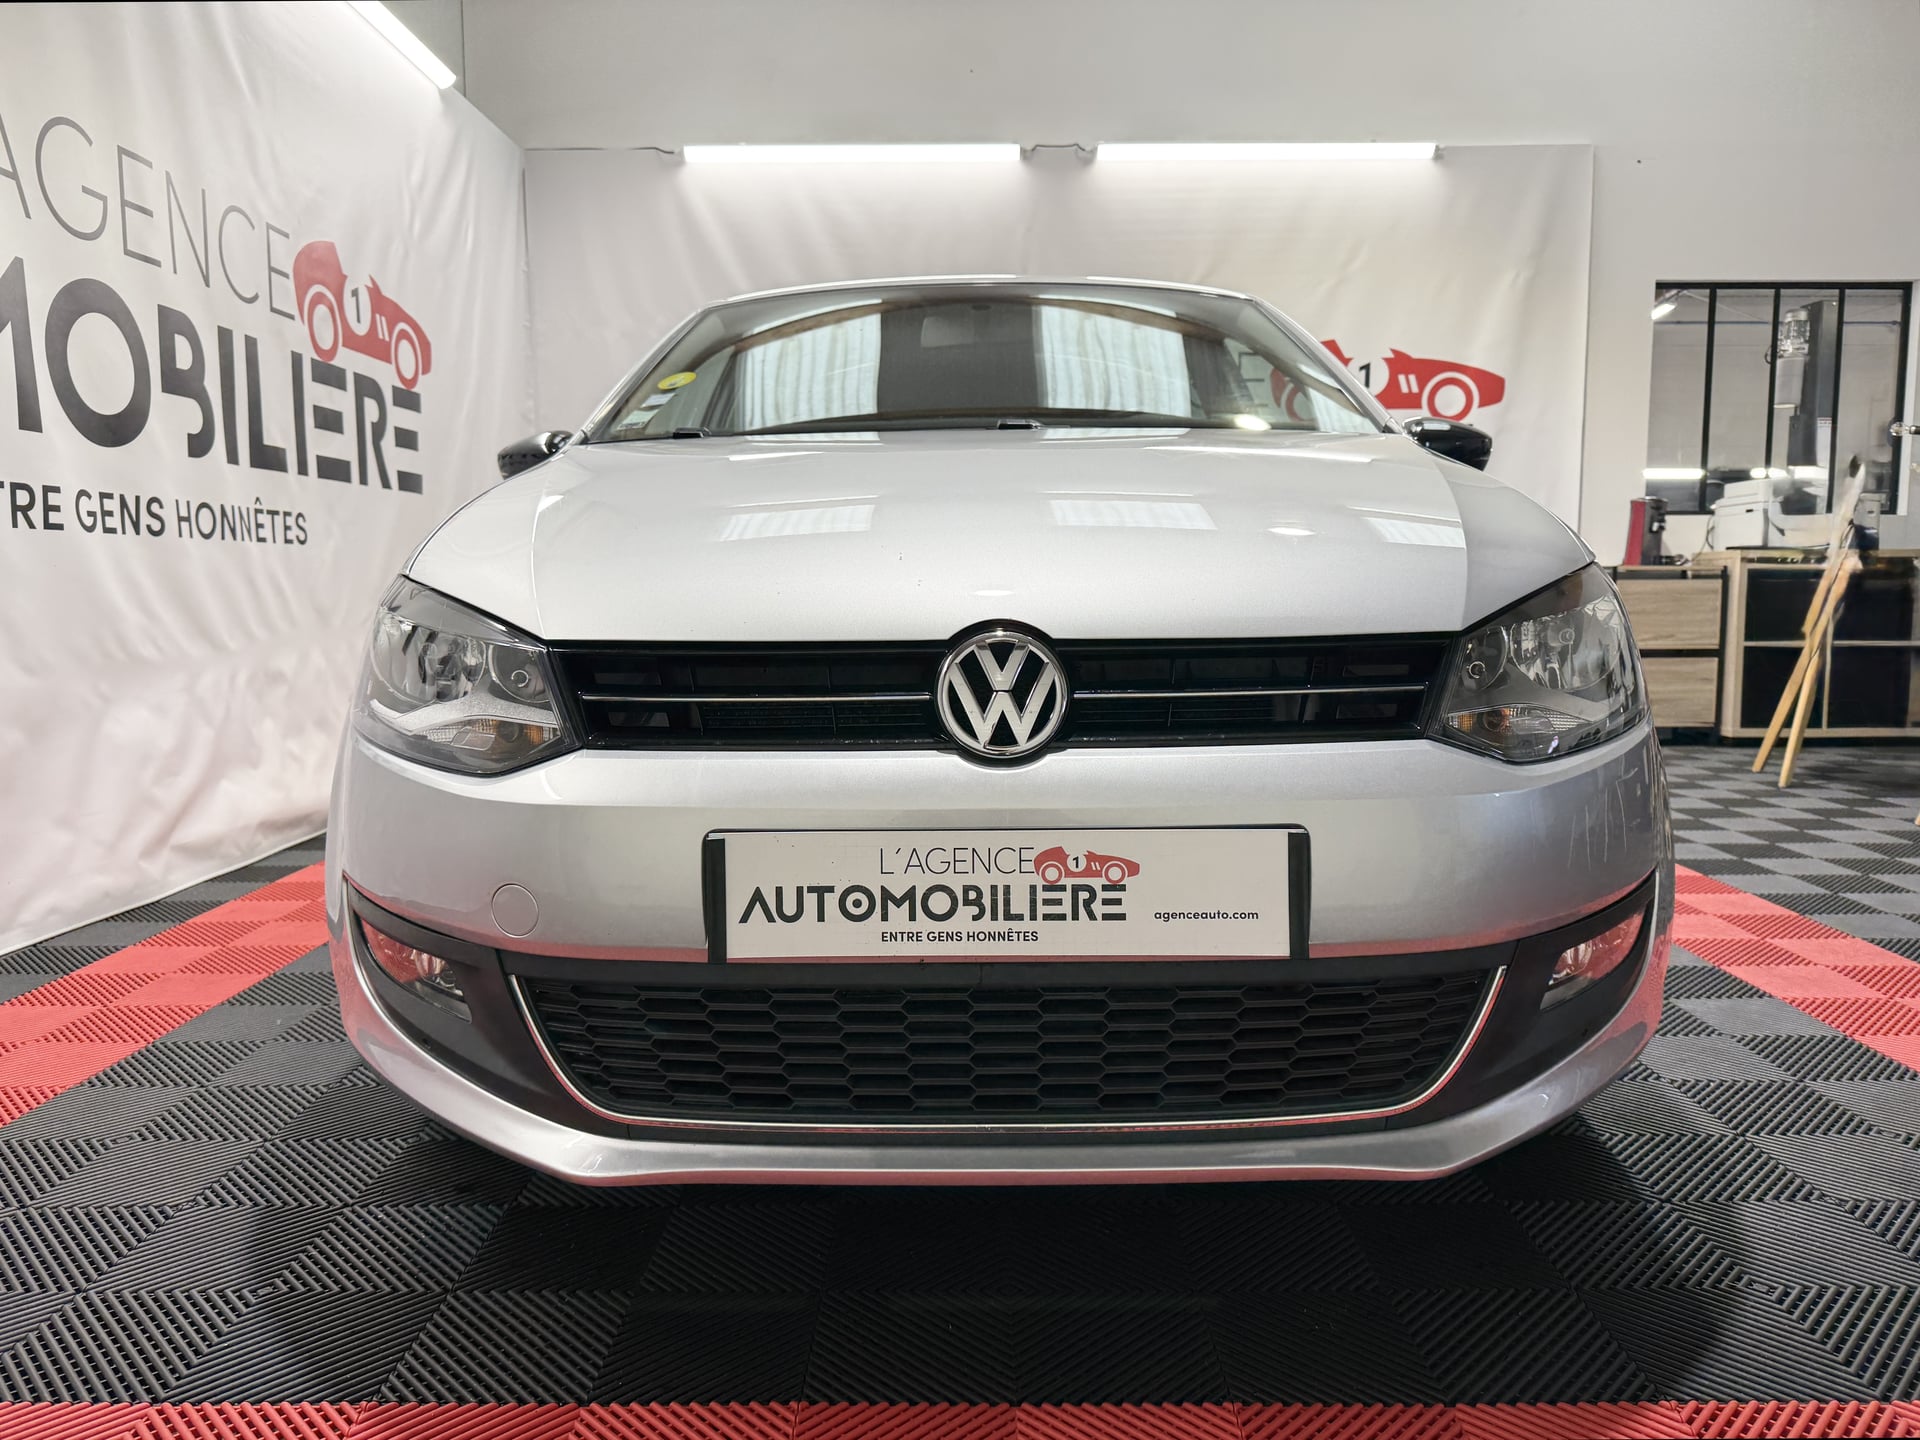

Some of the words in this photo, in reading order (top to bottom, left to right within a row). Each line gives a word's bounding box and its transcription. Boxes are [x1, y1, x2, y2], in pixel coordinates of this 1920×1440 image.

[351, 287, 361, 324] 1
[1359, 362, 1371, 388] 1
[0, 481, 65, 531] RE
[75, 488, 166, 537] GENS
[175, 496, 308, 546] HONNÊTES
[1072, 856, 1080, 869] 1
[738, 884, 1127, 923] AUTOMOBILIERE
[1153, 909, 1260, 923] agenceauto.com
[881, 931, 923, 943] ENTRE
[926, 931, 963, 943] GENS
[966, 928, 1039, 943] HONNÊTES
